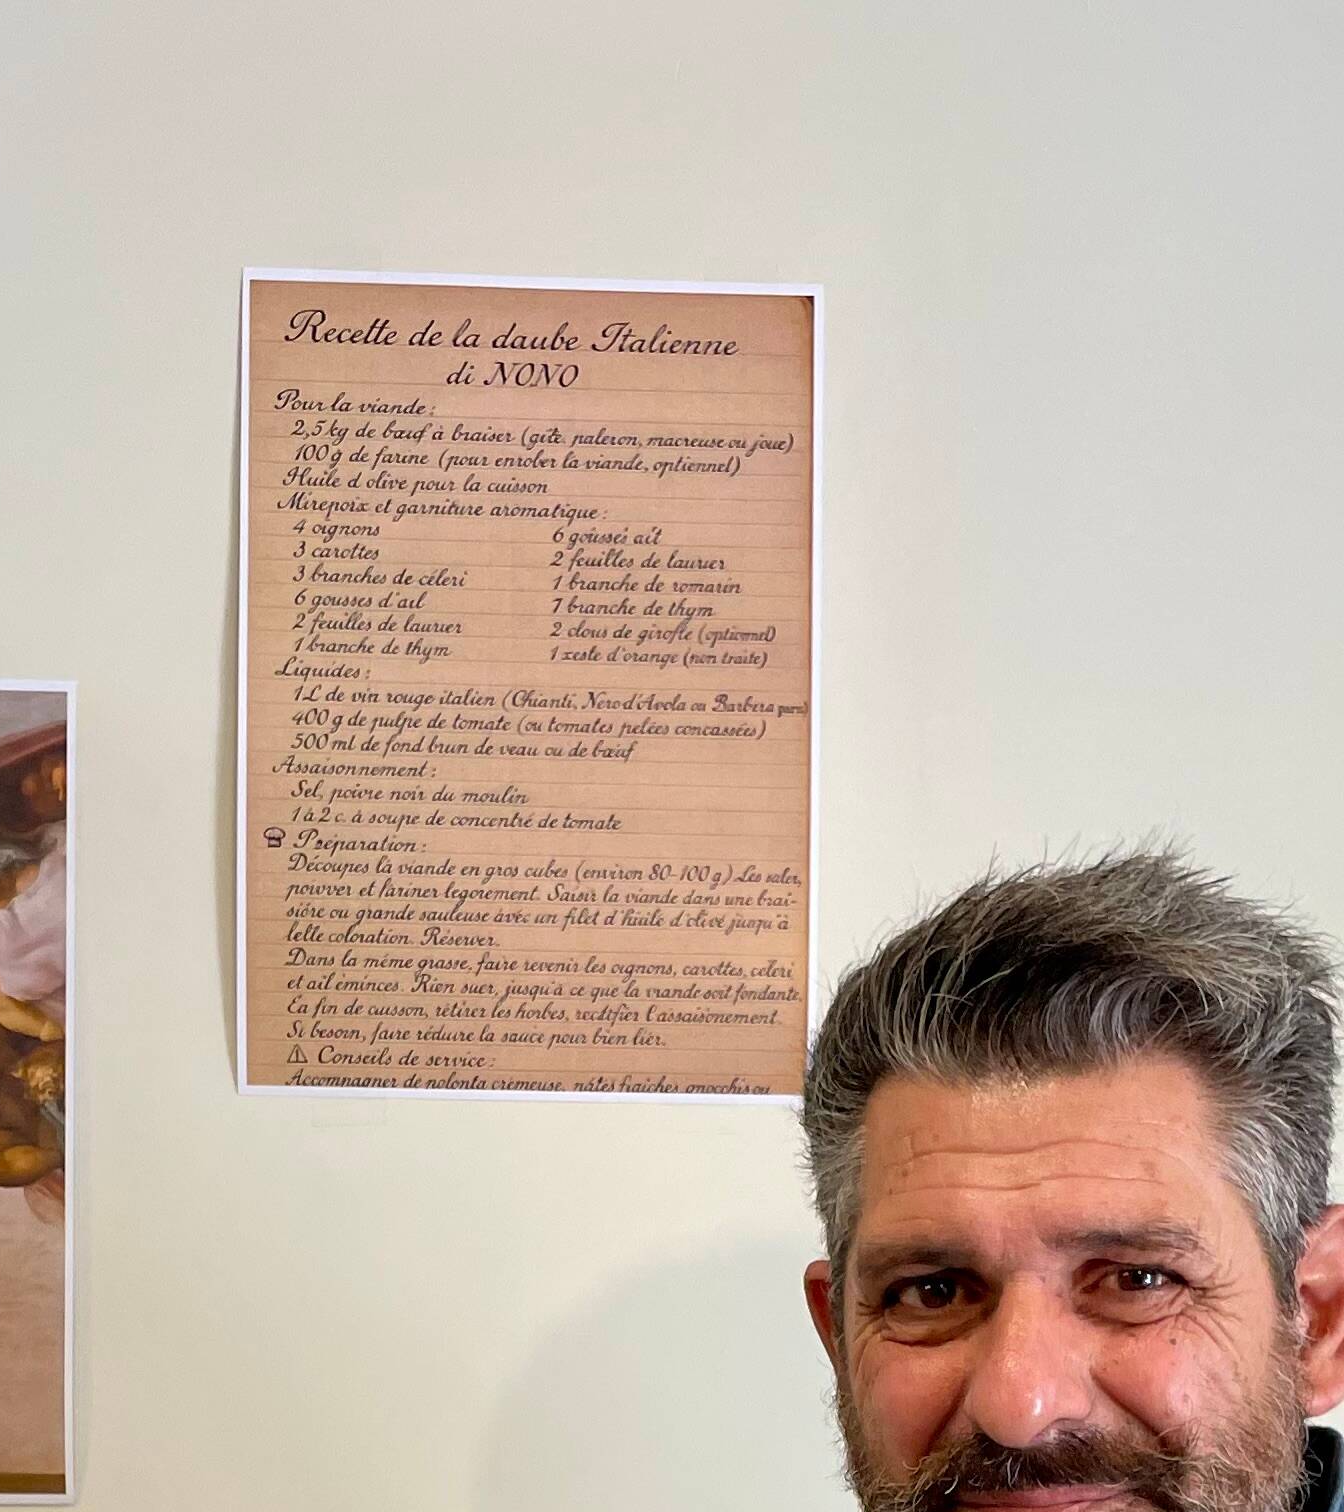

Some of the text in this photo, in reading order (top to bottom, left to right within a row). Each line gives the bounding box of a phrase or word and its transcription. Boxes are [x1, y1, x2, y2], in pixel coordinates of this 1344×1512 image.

[285, 309, 738, 356] Recette de la daube Italienne
[447, 361, 579, 387] di NONO
[275, 388, 329, 411] Pour
[331, 392, 353, 412] la
[356, 421, 376, 438] de
[451, 424, 515, 442] braiser
[349, 446, 369, 463] de
[438, 449, 488, 471] (pour
[282, 466, 547, 496] Huile pour la cuisson
[277, 491, 368, 518] Mirepoix
[375, 499, 391, 514] et
[393, 498, 483, 521] garniture
[293, 519, 306, 534] 4
[553, 526, 565, 543] 6
[293, 540, 379, 560] 3 carottes
[550, 551, 563, 566] 2
[567, 549, 634, 572] feuilles
[640, 552, 659, 568] de
[292, 563, 469, 587] 3 branches de céleri
[552, 573, 741, 594] 1 branche de romarin
[293, 588, 372, 613] 6 gousses
[567, 595, 713, 621] branche de thym
[292, 613, 306, 630] 2
[309, 612, 372, 634] feuilles
[378, 615, 397, 632] de
[550, 621, 632, 639] 2 de
[294, 634, 450, 664] 1 branche de thym
[326, 685, 344, 702] de
[352, 689, 379, 703] vin
[387, 692, 433, 711] rouge
[439, 689, 496, 707] italien
[347, 710, 367, 727] de
[427, 712, 446, 729] de
[452, 714, 511, 731] tomate
[517, 714, 542, 735] (ou
[548, 716, 613, 733] tomates
[619, 716, 670, 737] pelées
[361, 736, 380, 751] de
[383, 736, 421, 758] fond
[428, 736, 469, 754] brun
[474, 738, 493, 755] de
[499, 744, 539, 757] veau
[545, 746, 562, 757] ou
[568, 741, 587, 757] de
[329, 782, 383, 805] poivre
[390, 785, 425, 801] noir
[432, 785, 456, 802] du
[462, 785, 529, 804] moulin
[291, 807, 301, 822] 1
[318, 807, 332, 822] 2
[369, 813, 420, 832] soupe
[425, 809, 445, 826] de
[538, 813, 559, 828] de
[562, 812, 623, 830] tomate
[398, 859, 456, 876] viande
[460, 865, 480, 876] en
[482, 866, 518, 884] gros
[524, 859, 568, 879] cubes
[359, 881, 376, 896] et
[603, 885, 619, 903] la
[625, 887, 678, 904] viande
[682, 890, 720, 905] dans
[725, 894, 753, 905] une
[329, 904, 556, 925] ou grande un
[285, 947, 606, 976] Dans la faire revenir les
[287, 975, 301, 990] et
[287, 1020, 306, 1038] Si
[370, 1021, 410, 1045] faire
[479, 1024, 496, 1041] la
[548, 1033, 587, 1050] pour
[592, 1027, 627, 1046] bien
[318, 1045, 392, 1065] Conseils
[398, 1050, 420, 1066] de
